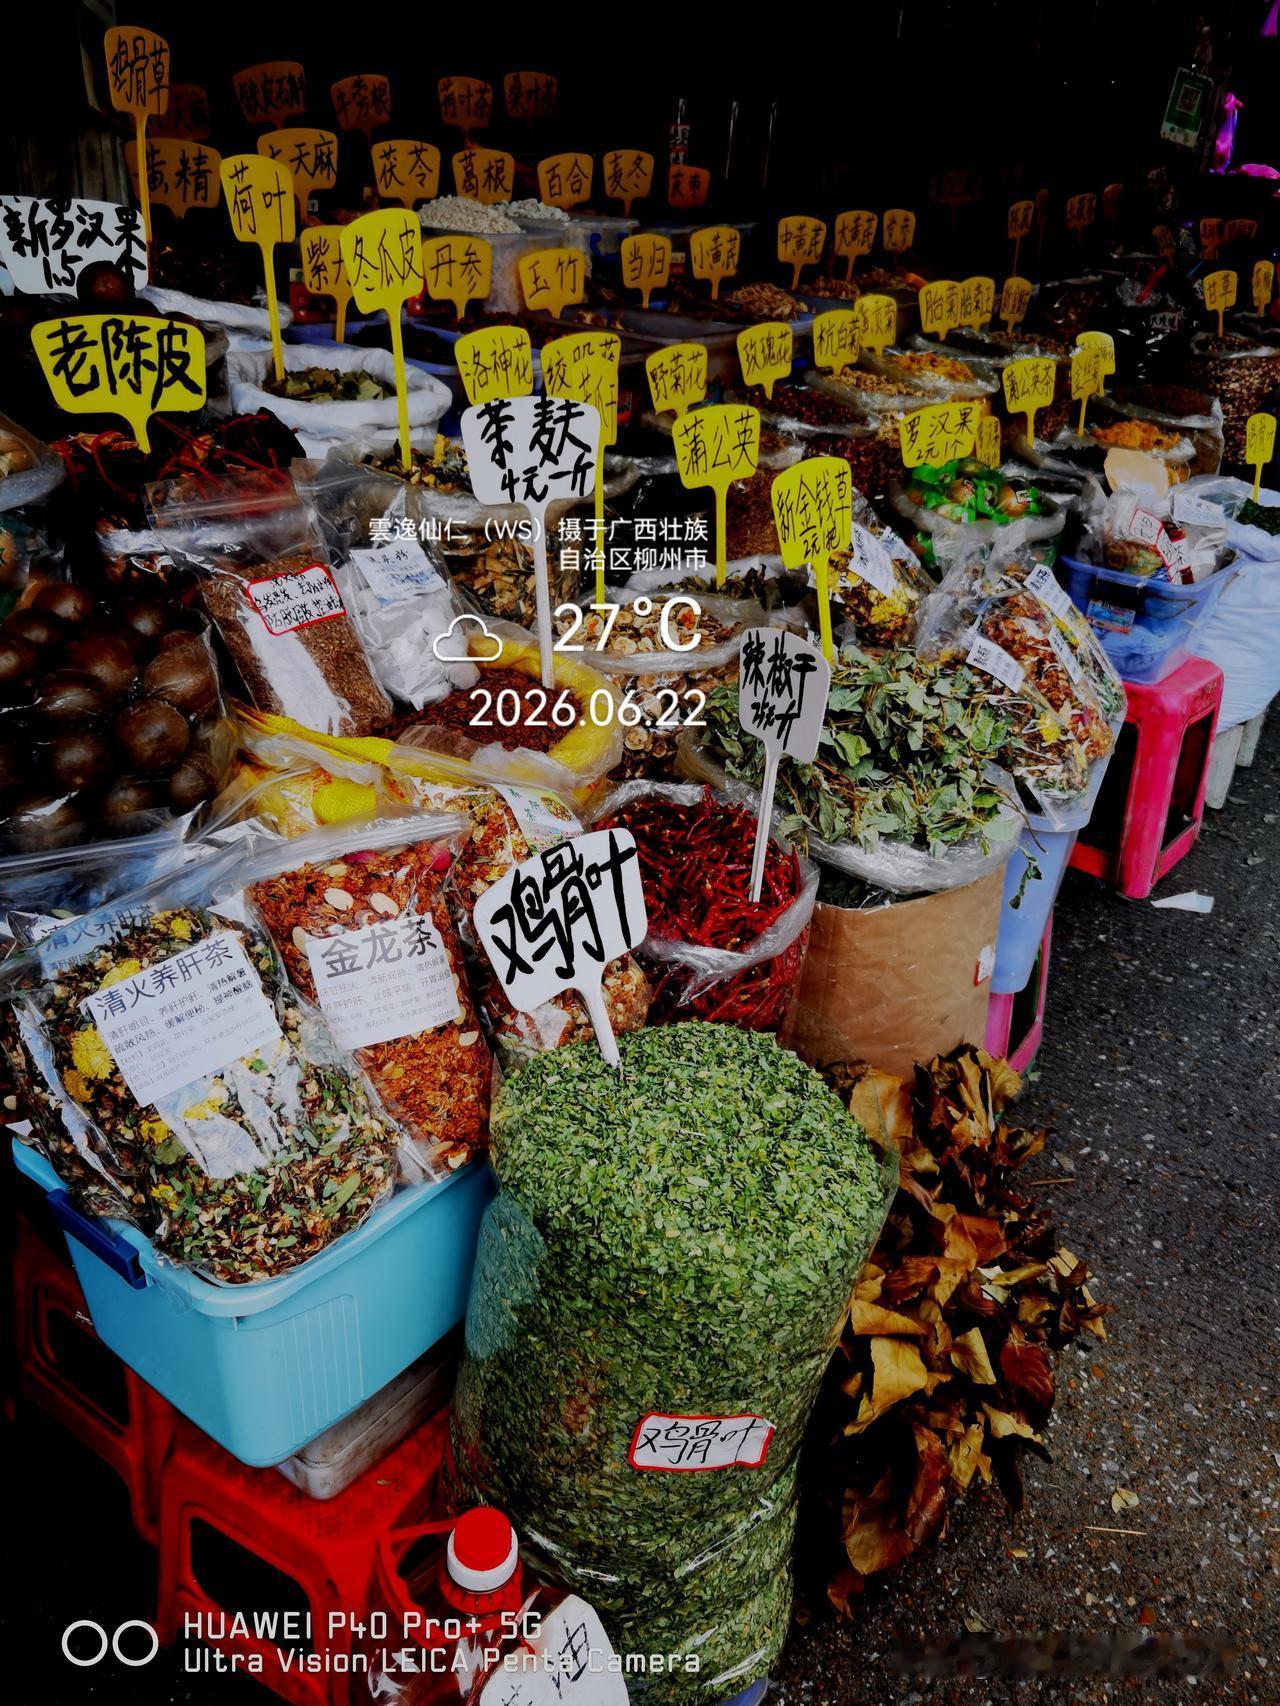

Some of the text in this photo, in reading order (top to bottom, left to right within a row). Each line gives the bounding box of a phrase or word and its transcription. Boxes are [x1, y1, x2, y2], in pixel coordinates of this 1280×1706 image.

[379, 145, 433, 190] 茯苓
[456, 151, 511, 197] 葛根
[545, 159, 590, 198] 百合
[608, 153, 648, 196] 麦冬
[228, 159, 287, 243] 荷叶
[3, 198, 147, 257] 新罗汉果
[693, 230, 740, 273] 小黄芪
[352, 219, 424, 292] 冬瓜皮
[430, 243, 482, 294] 丹参
[528, 255, 578, 299] 玉竹
[628, 241, 665, 282] 当归
[47, 318, 203, 411] 老陈皮
[462, 335, 533, 400] 洛神花
[650, 349, 708, 402] 野菊花
[742, 330, 793, 376] 玫瑰花
[678, 409, 758, 477] 蒲公英
[904, 406, 974, 453] 罗汉果
[490, 830, 637, 985] 鸡骨叶
[320, 917, 437, 978] 金龙茶
[96, 938, 234, 1021] 清火养肝茶
